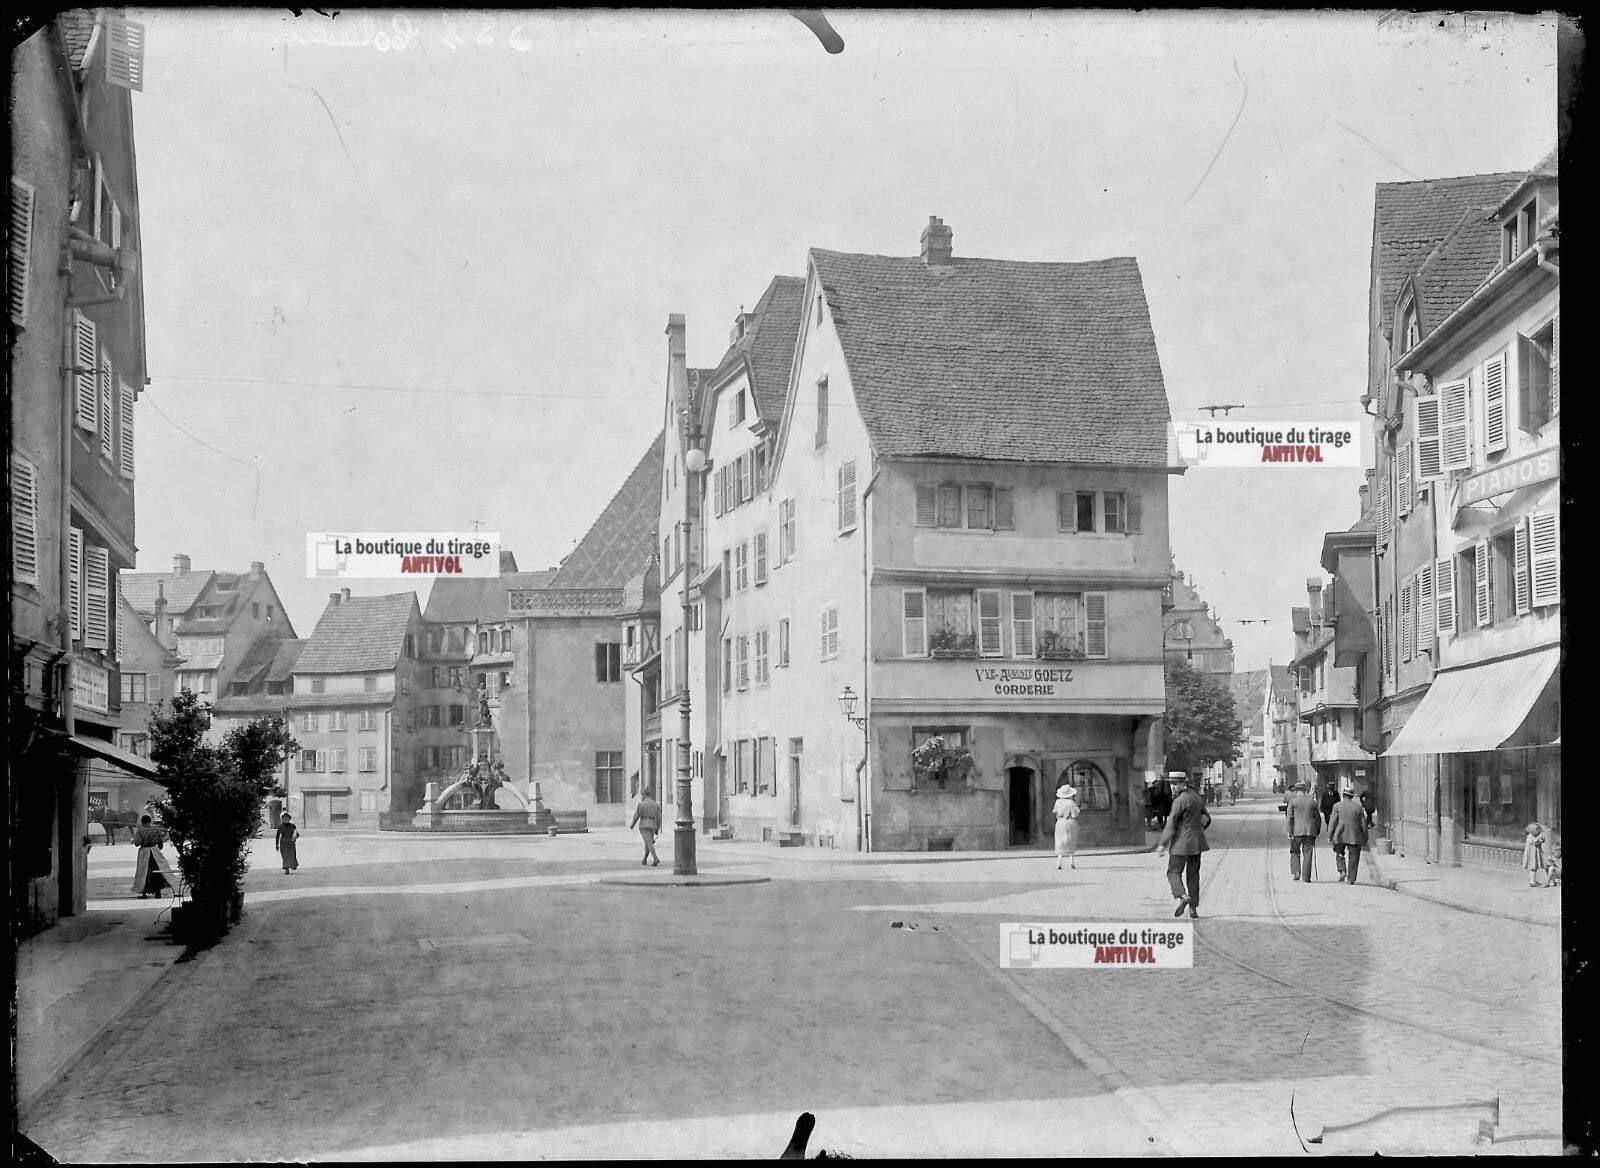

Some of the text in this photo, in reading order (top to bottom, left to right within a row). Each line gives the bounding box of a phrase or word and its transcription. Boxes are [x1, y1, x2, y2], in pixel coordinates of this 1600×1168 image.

[1466, 454, 1550, 500] PIANOS
[1034, 669, 1074, 682] GOETZ
[994, 684, 1054, 695] CORDERIE
